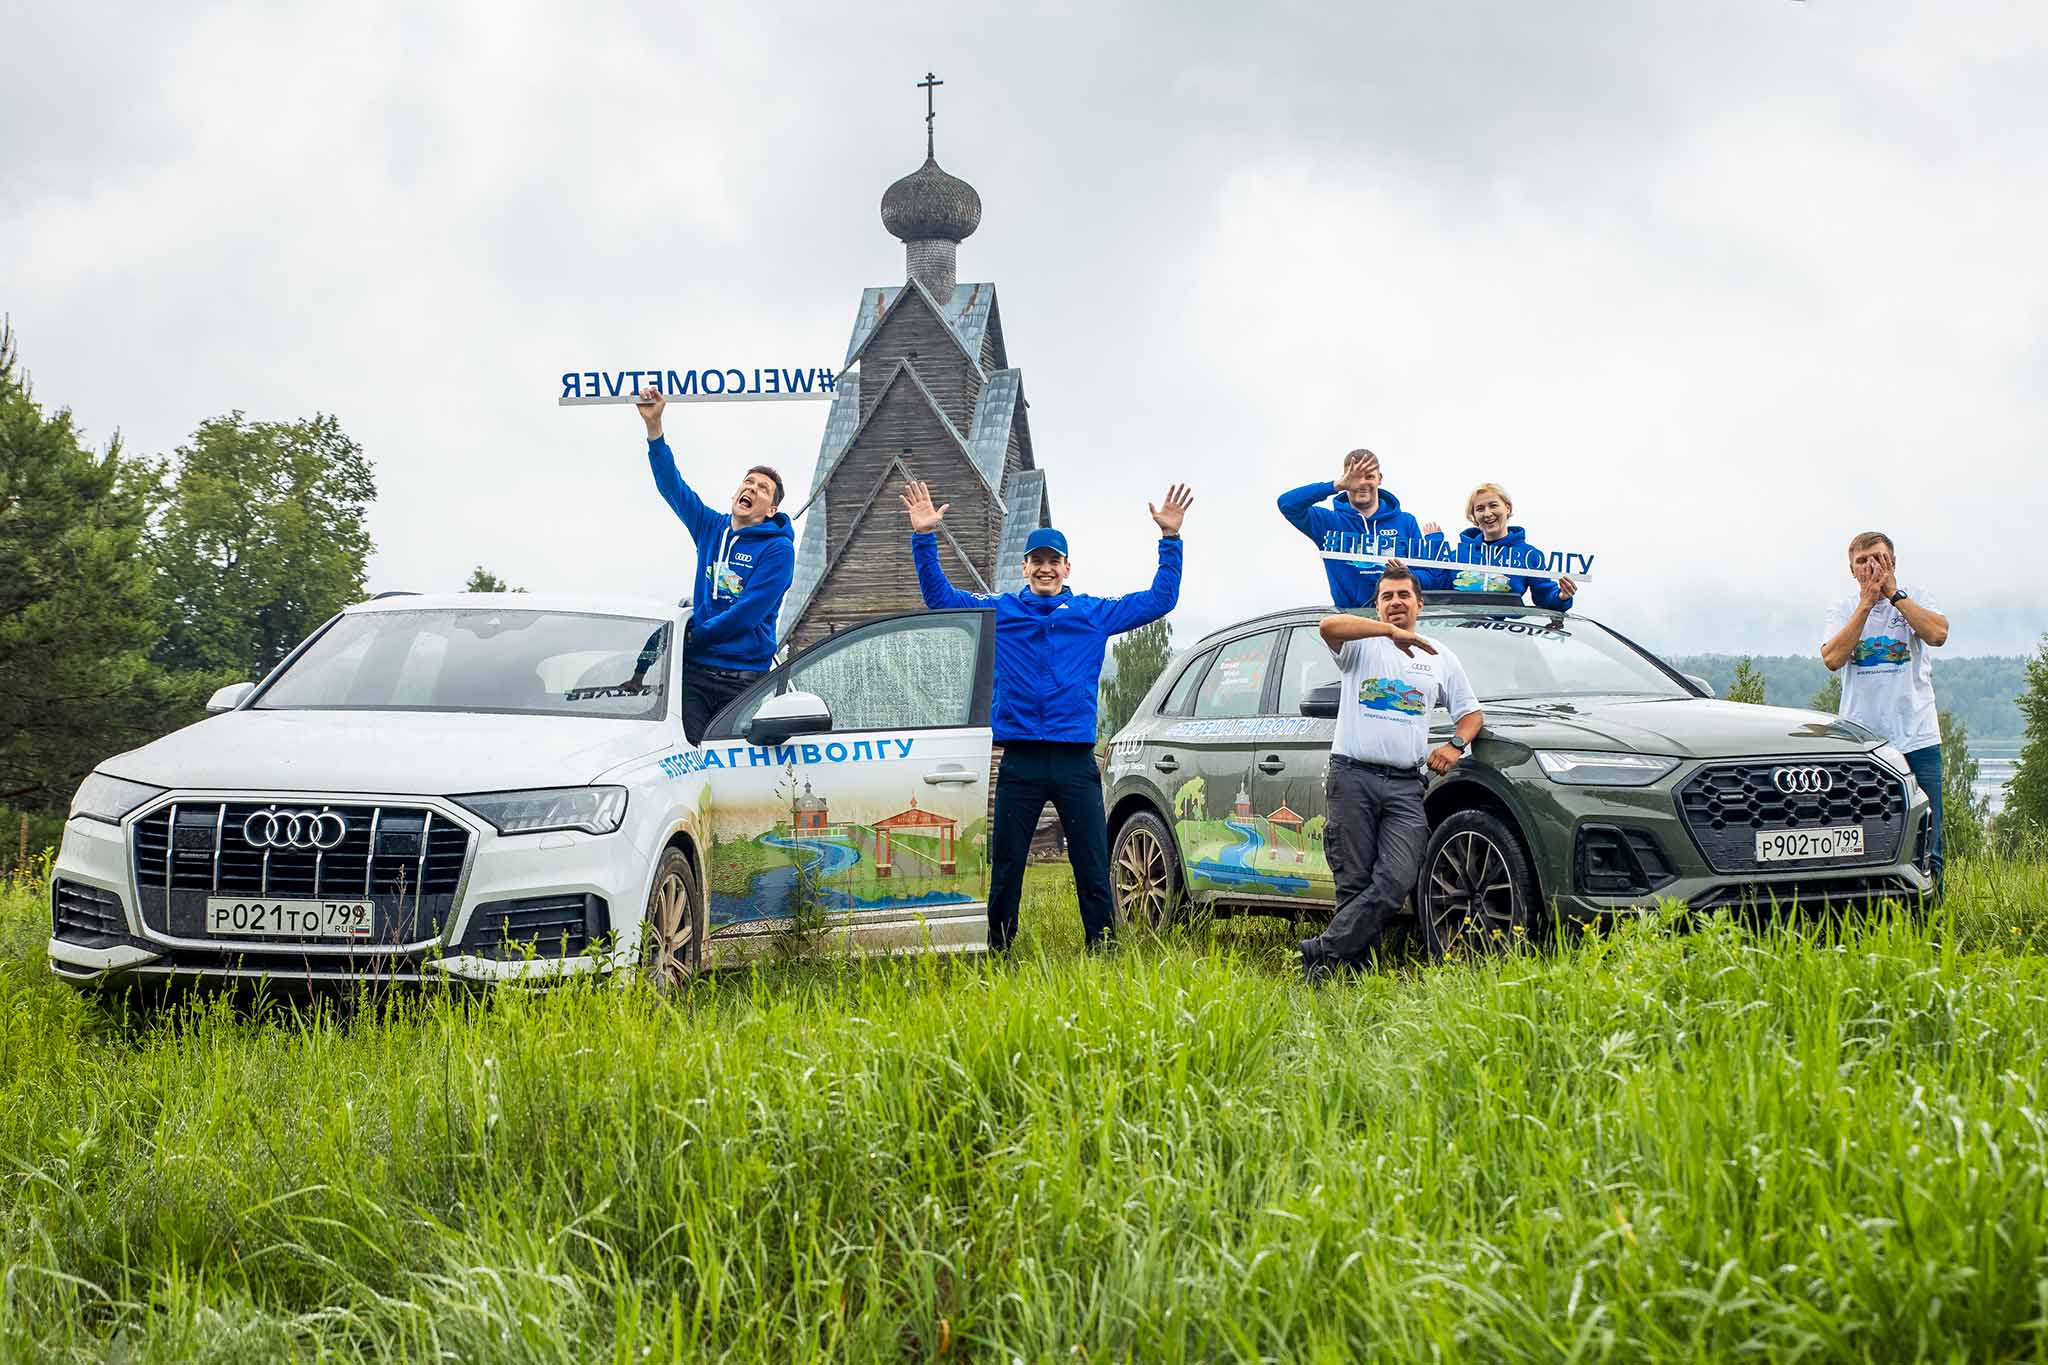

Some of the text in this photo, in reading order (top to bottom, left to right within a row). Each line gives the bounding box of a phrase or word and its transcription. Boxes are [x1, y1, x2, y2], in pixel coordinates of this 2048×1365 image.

[1167, 717, 1318, 736] ПЕРЕШАГНИВОЛГУ
[1834, 830, 1859, 847] 799
[325, 904, 365, 925] 799
